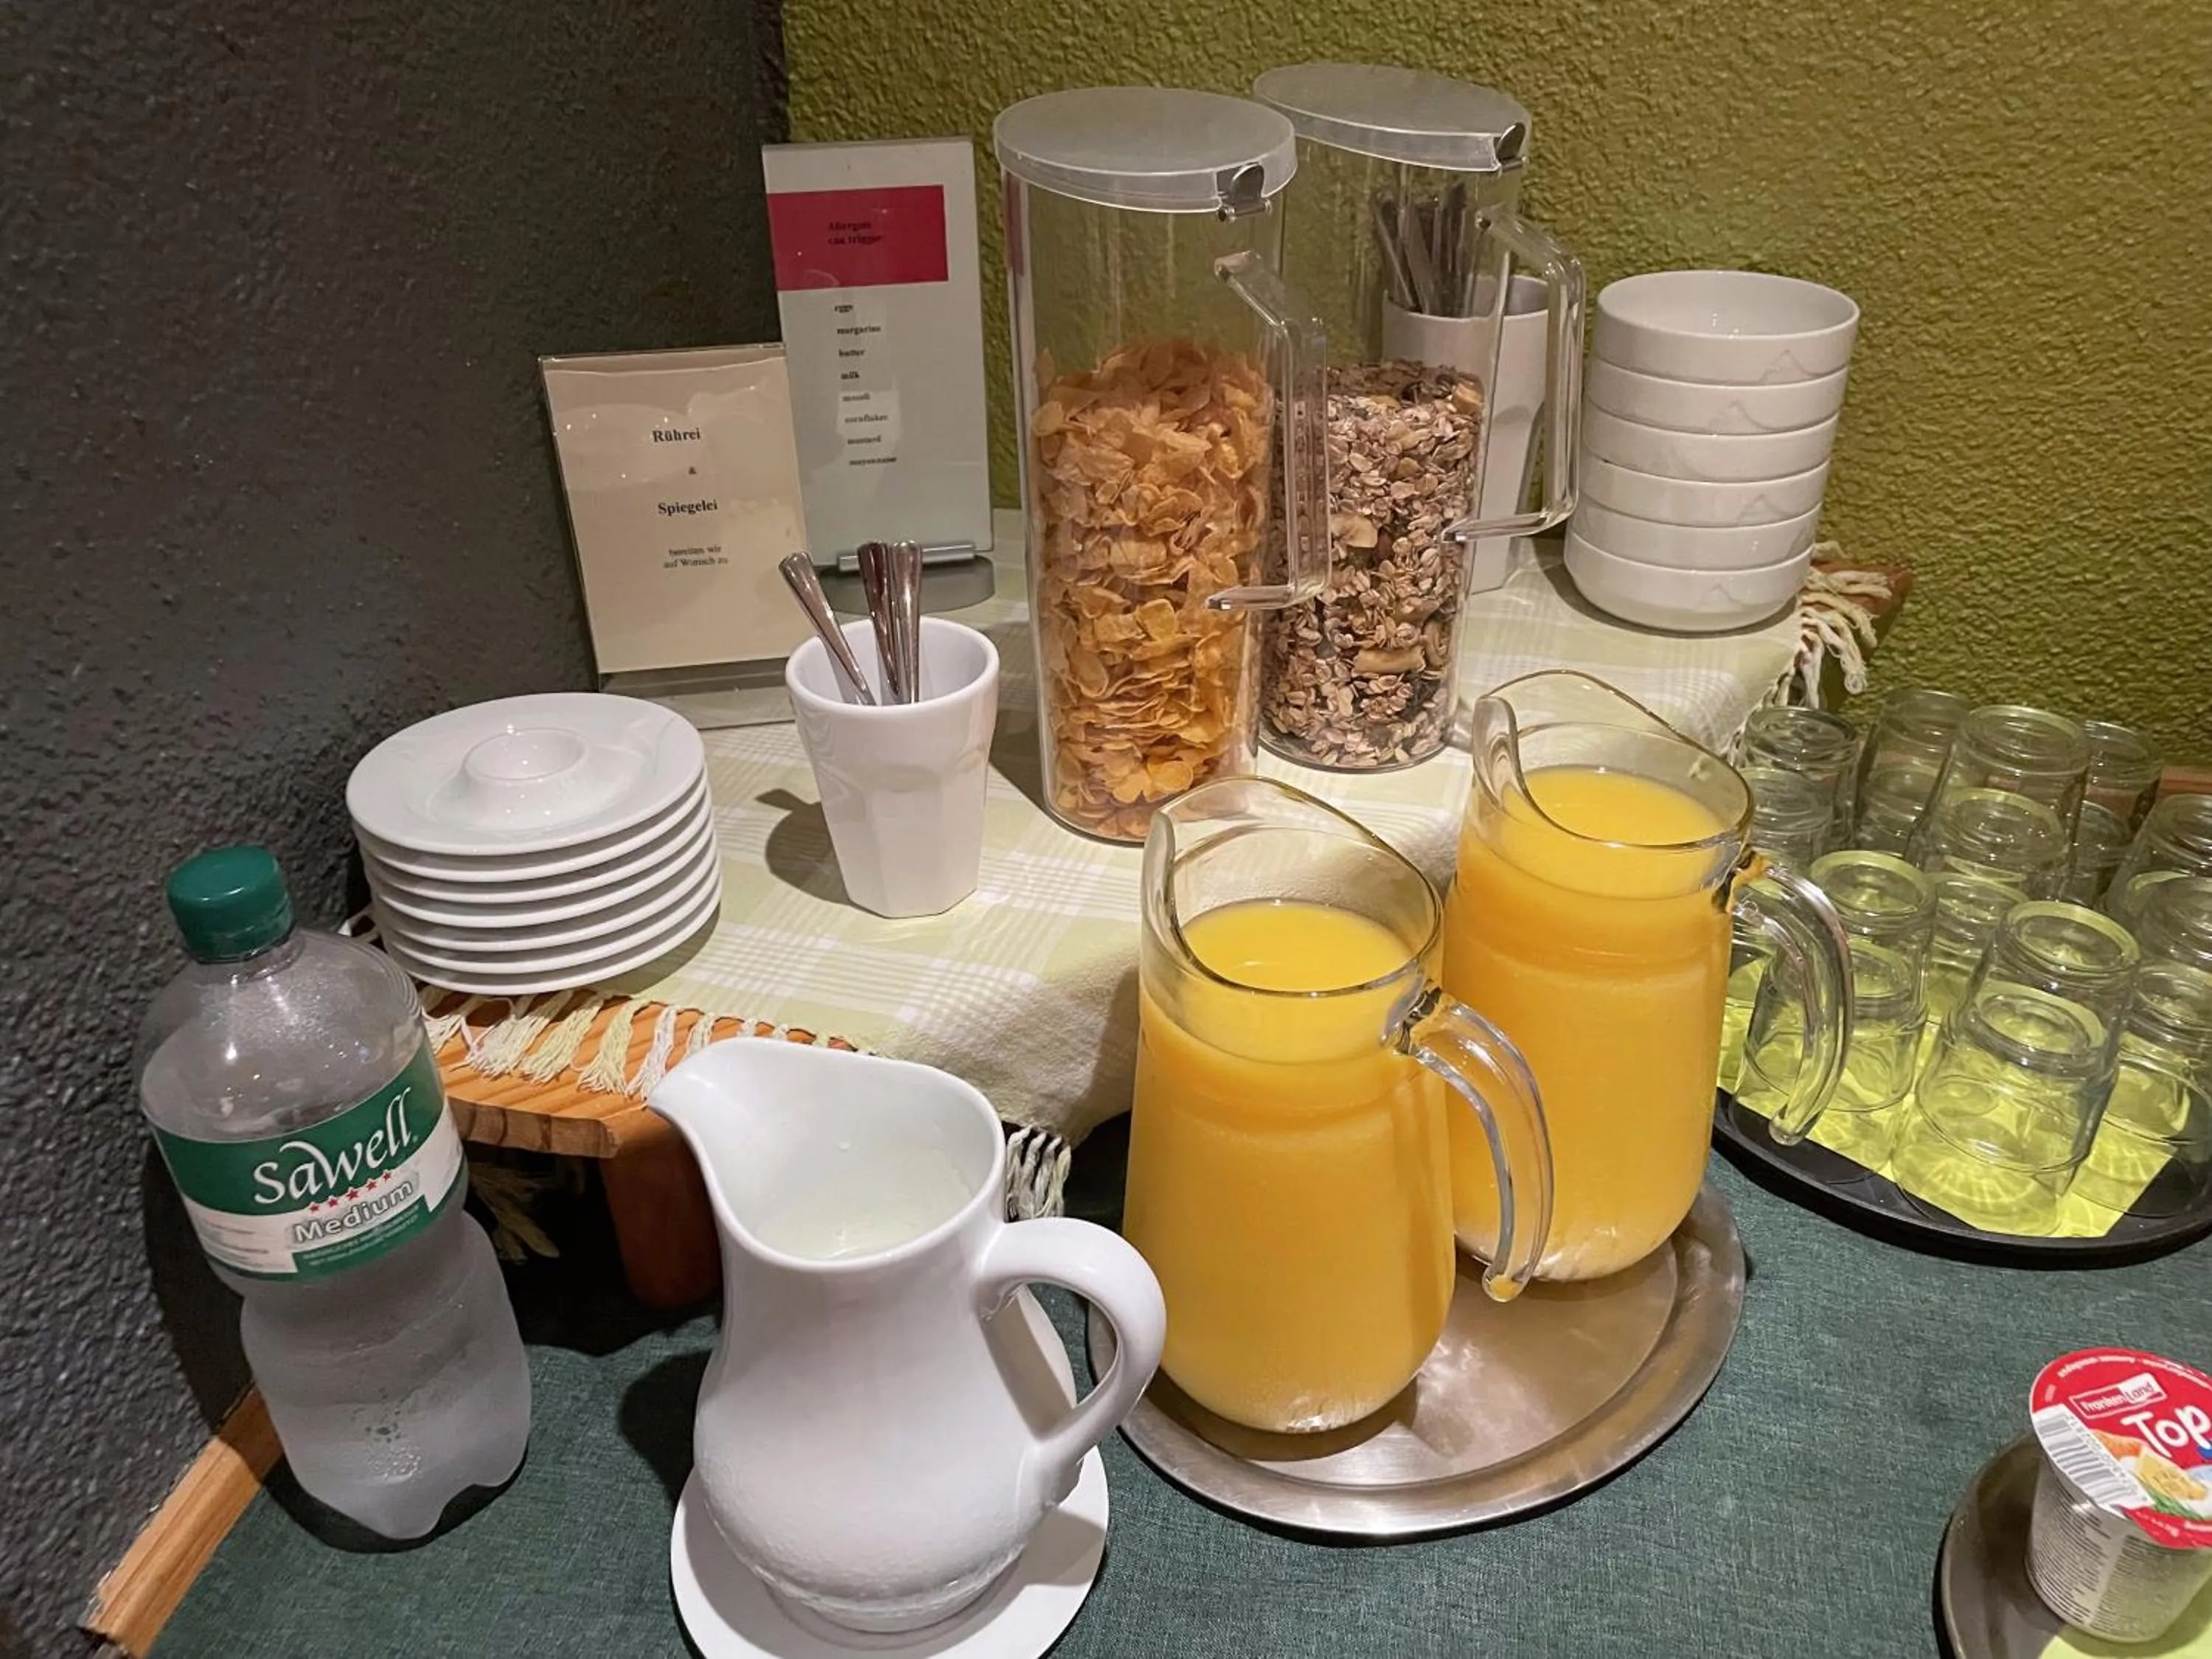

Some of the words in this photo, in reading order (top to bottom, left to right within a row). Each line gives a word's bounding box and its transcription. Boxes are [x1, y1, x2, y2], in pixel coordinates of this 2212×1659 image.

[838, 349, 865, 357] butter
[841, 371, 860, 380] milk
[652, 428, 700, 442] Rührei
[688, 466, 697, 475] &
[658, 499, 718, 517] Spiegelei
[293, 1180, 414, 1245] Medium
